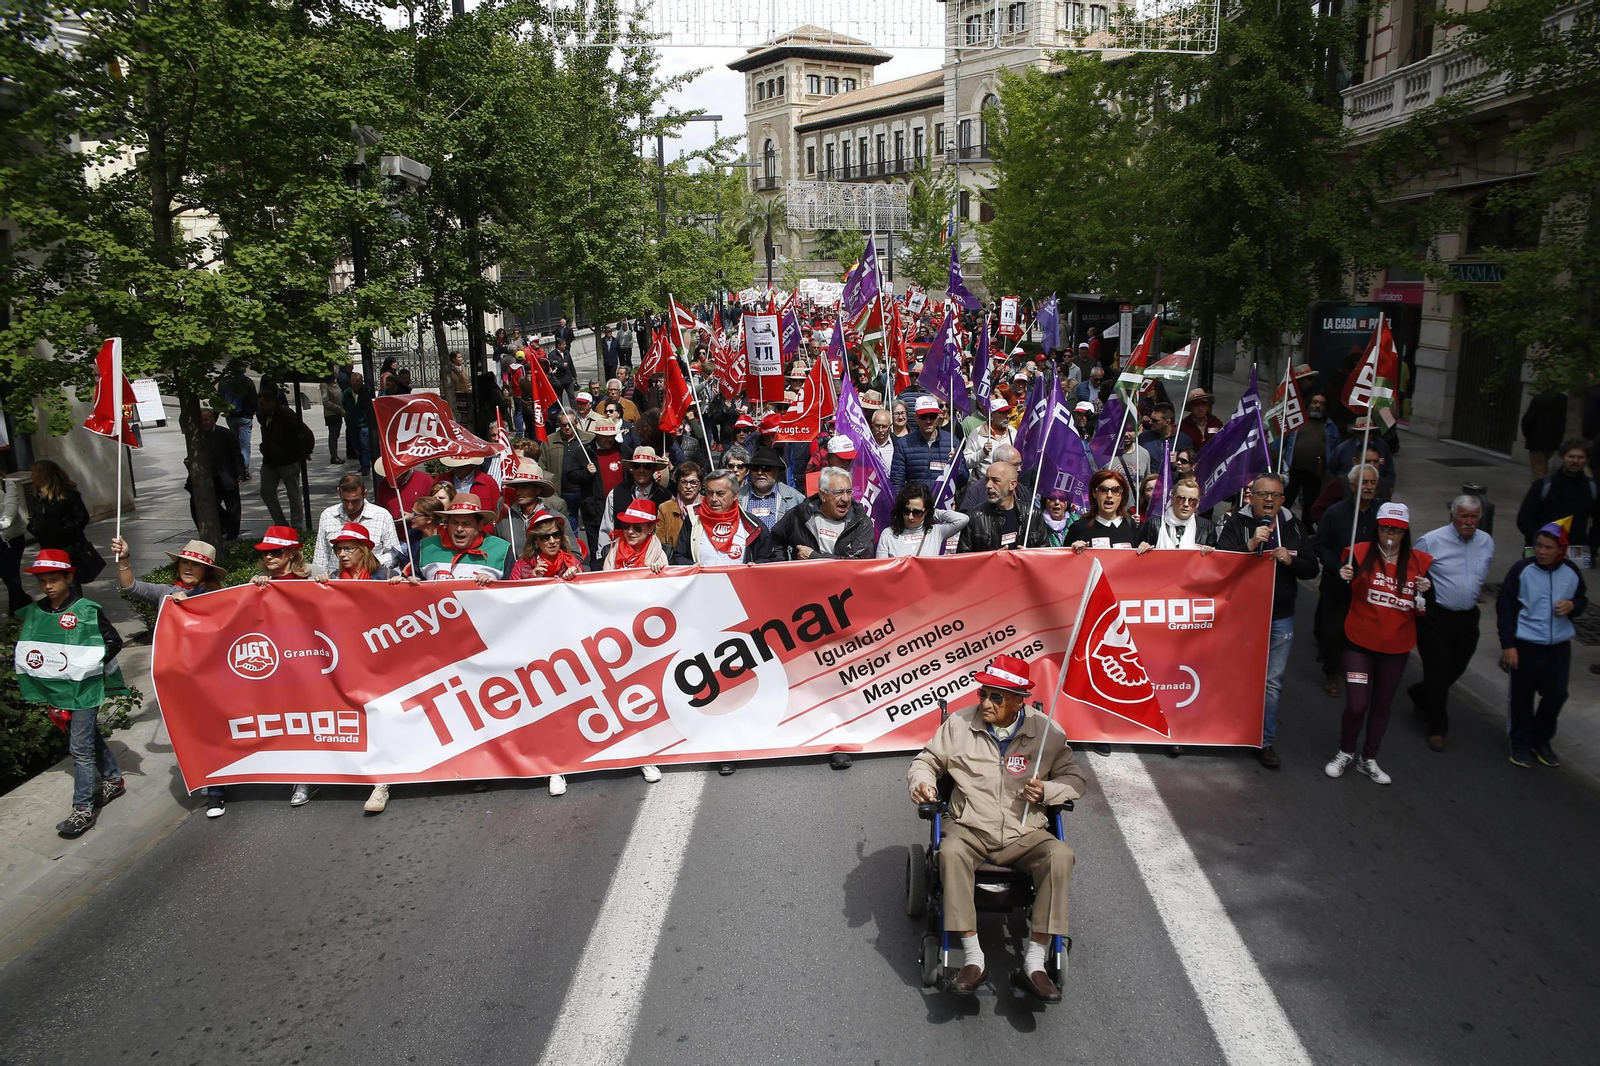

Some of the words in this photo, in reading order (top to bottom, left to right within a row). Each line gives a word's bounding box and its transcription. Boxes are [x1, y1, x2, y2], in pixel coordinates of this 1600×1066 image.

[1323, 318, 1333, 330] LA
[1335, 318, 1357, 330] CASA
[1360, 320, 1367, 328] DE
[1369, 318, 1392, 330] PAL
[1373, 579, 1385, 588] DE
[362, 595, 465, 655] mayo
[1168, 622, 1213, 631] Granada
[235, 641, 270, 659] UGT
[284, 648, 330, 659] Granada
[814, 618, 896, 667] Igualdad
[838, 650, 892, 686] Mejor
[896, 618, 965, 657] empleo
[577, 683, 658, 743] de
[674, 587, 854, 708] ganar
[862, 656, 942, 704] Mayores
[944, 622, 1017, 664] salarios
[400, 606, 678, 746] Tiempo
[1150, 682, 1192, 691] Granada
[885, 669, 978, 722] Pensiones
[228, 711, 337, 739] CCOO
[313, 733, 359, 744] Granada
[1007, 756, 1025, 768] UGT
